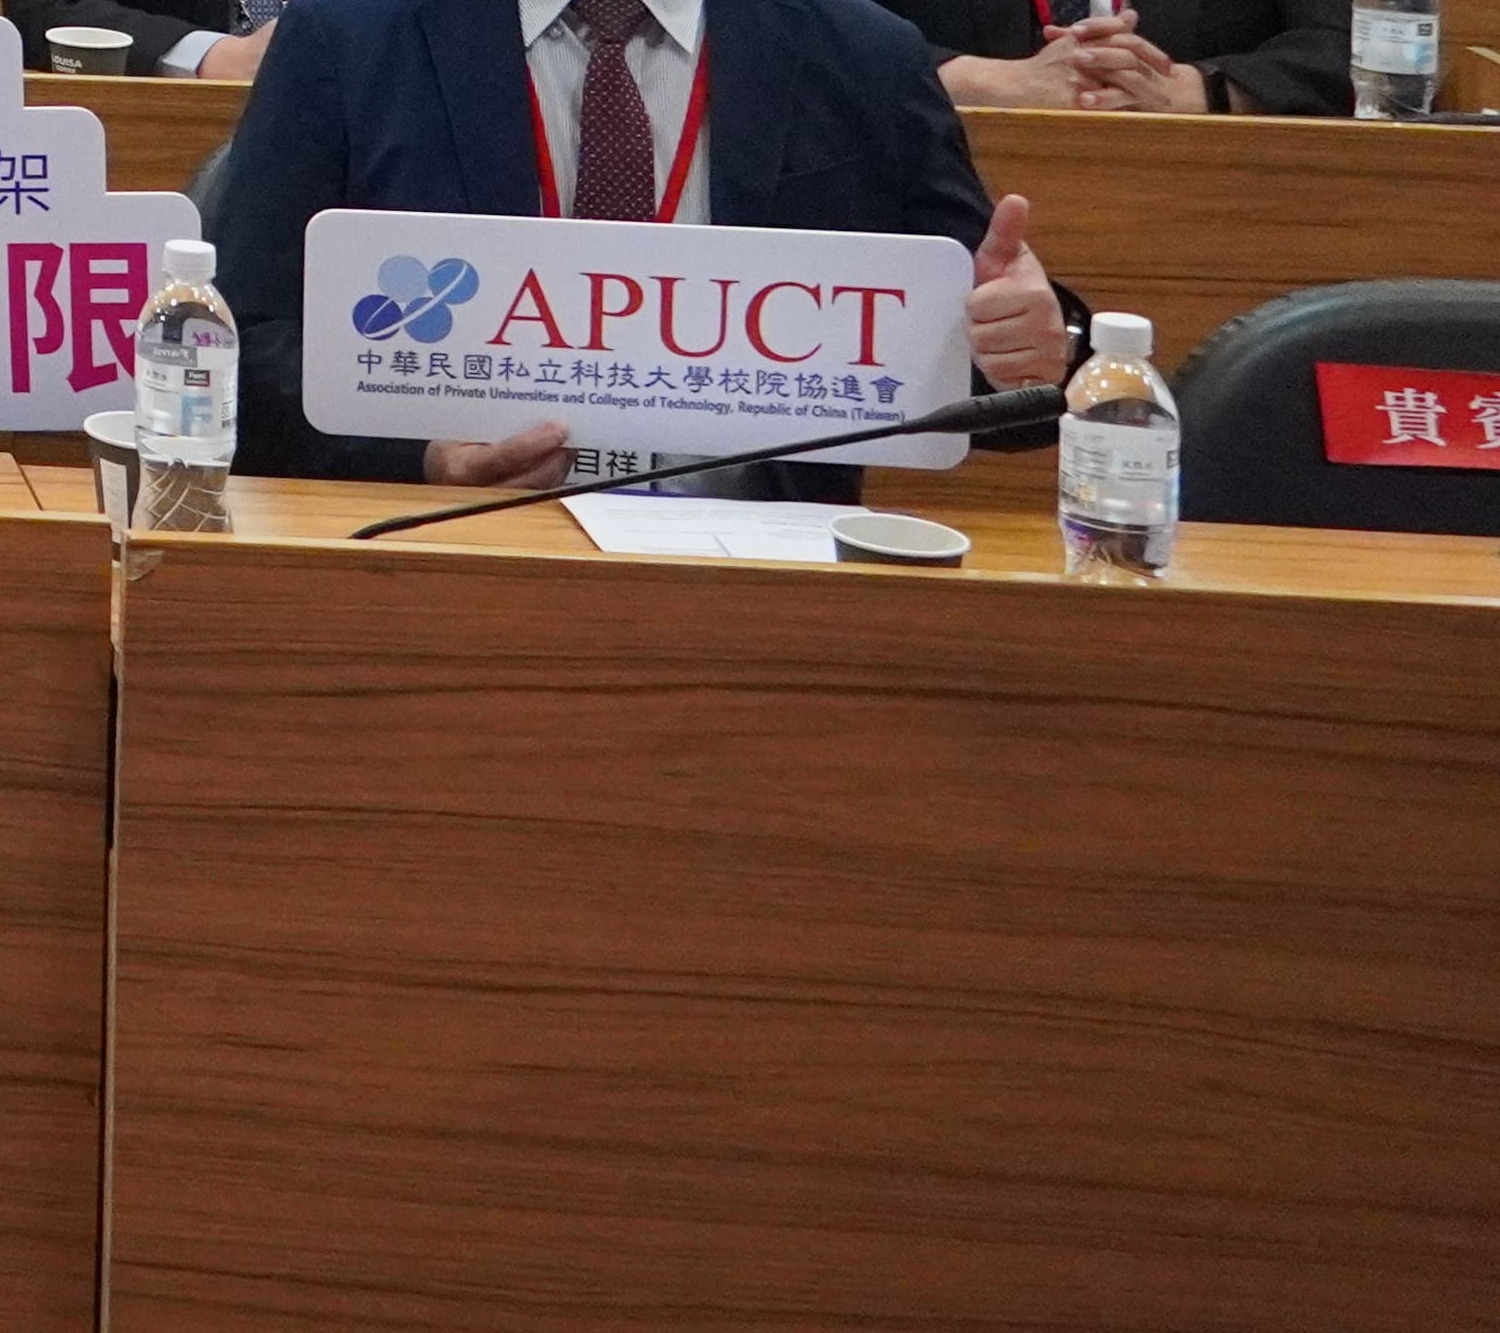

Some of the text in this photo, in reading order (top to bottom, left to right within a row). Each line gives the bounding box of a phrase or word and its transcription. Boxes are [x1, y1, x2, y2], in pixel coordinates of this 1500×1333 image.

[487, 268, 906, 367] APUCT
[357, 349, 905, 404] 中華民國私立科技大學校院協進會
[357, 381, 425, 396] Association
[428, 384, 441, 396] of
[444, 386, 486, 400] Private
[490, 387, 560, 404] Universities
[562, 392, 586, 405] and
[589, 393, 639, 410] Colleges
[643, 396, 656, 408] of
[738, 401, 792, 417] Republic
[796, 404, 809, 416] of
[812, 405, 847, 419] China
